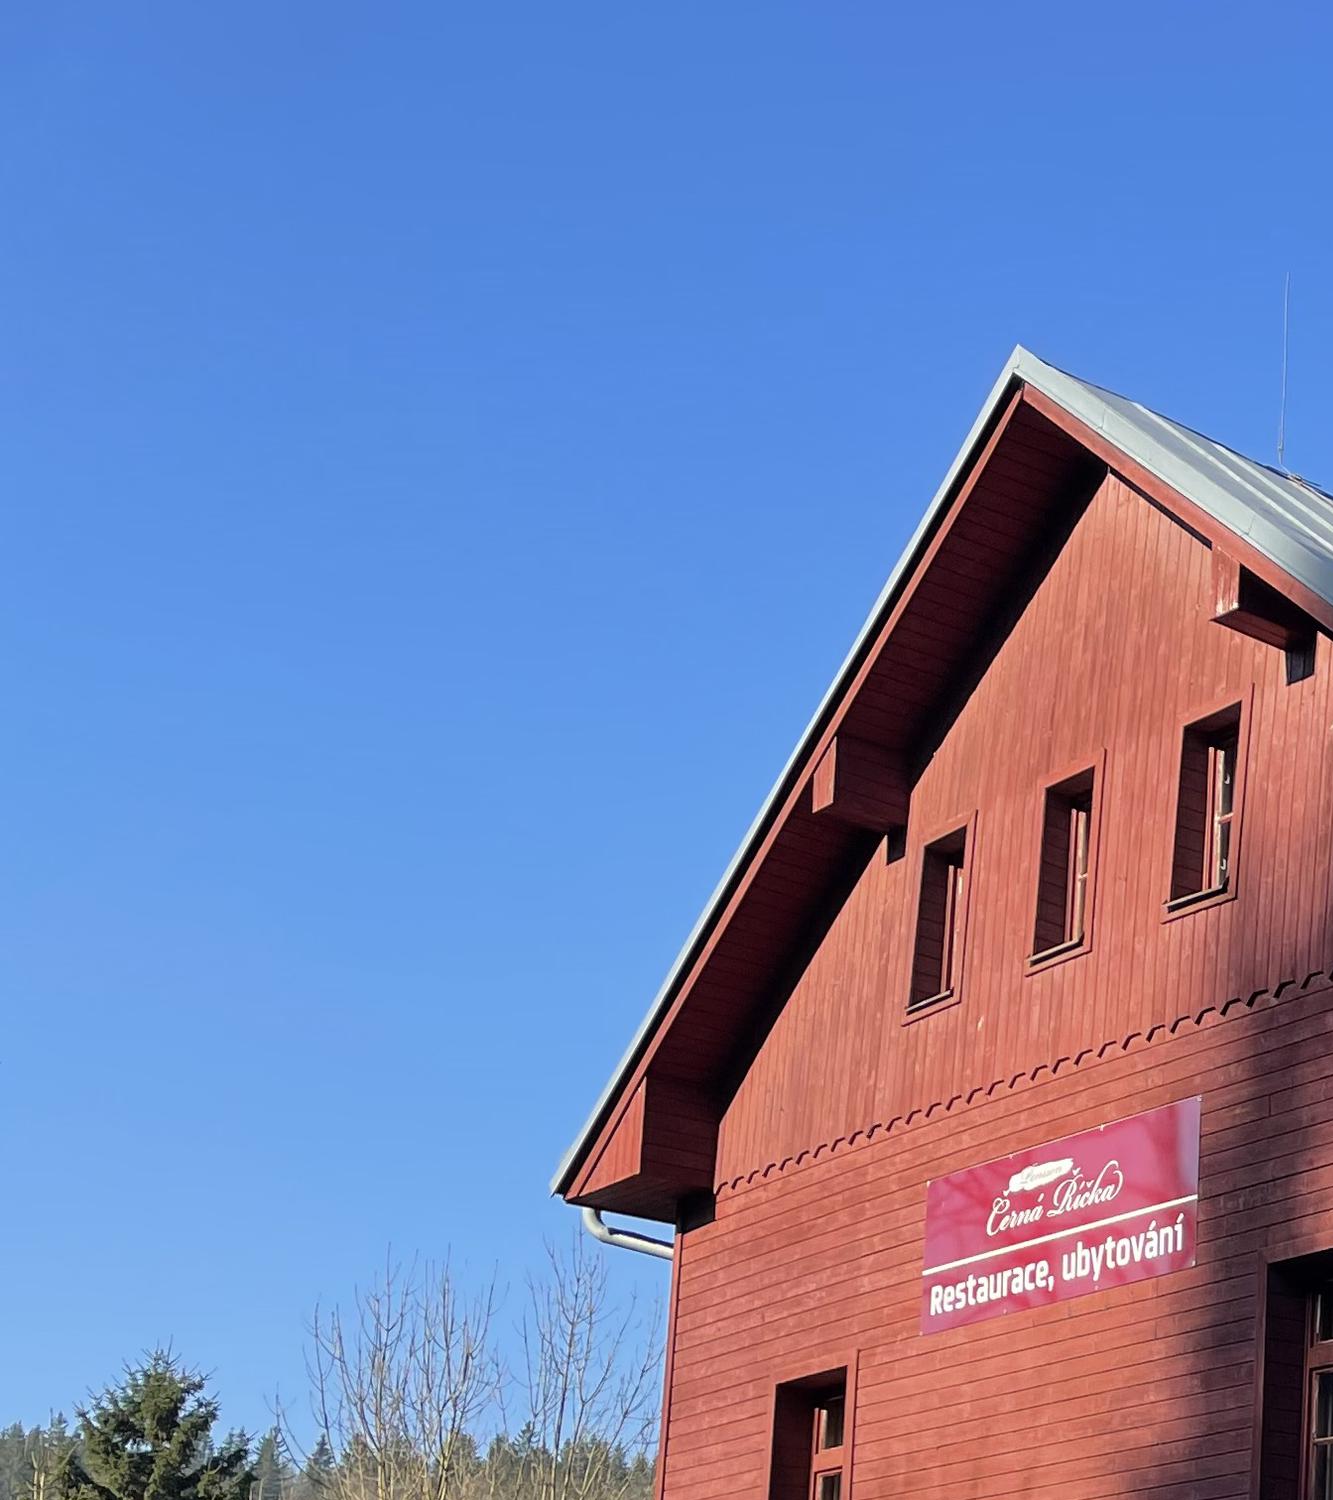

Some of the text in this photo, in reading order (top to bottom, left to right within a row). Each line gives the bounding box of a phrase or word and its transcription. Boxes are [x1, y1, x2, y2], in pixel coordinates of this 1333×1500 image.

[986, 1160, 1124, 1236] Černá Říčka
[930, 1213, 1184, 1316] Restaurace, ubytování
